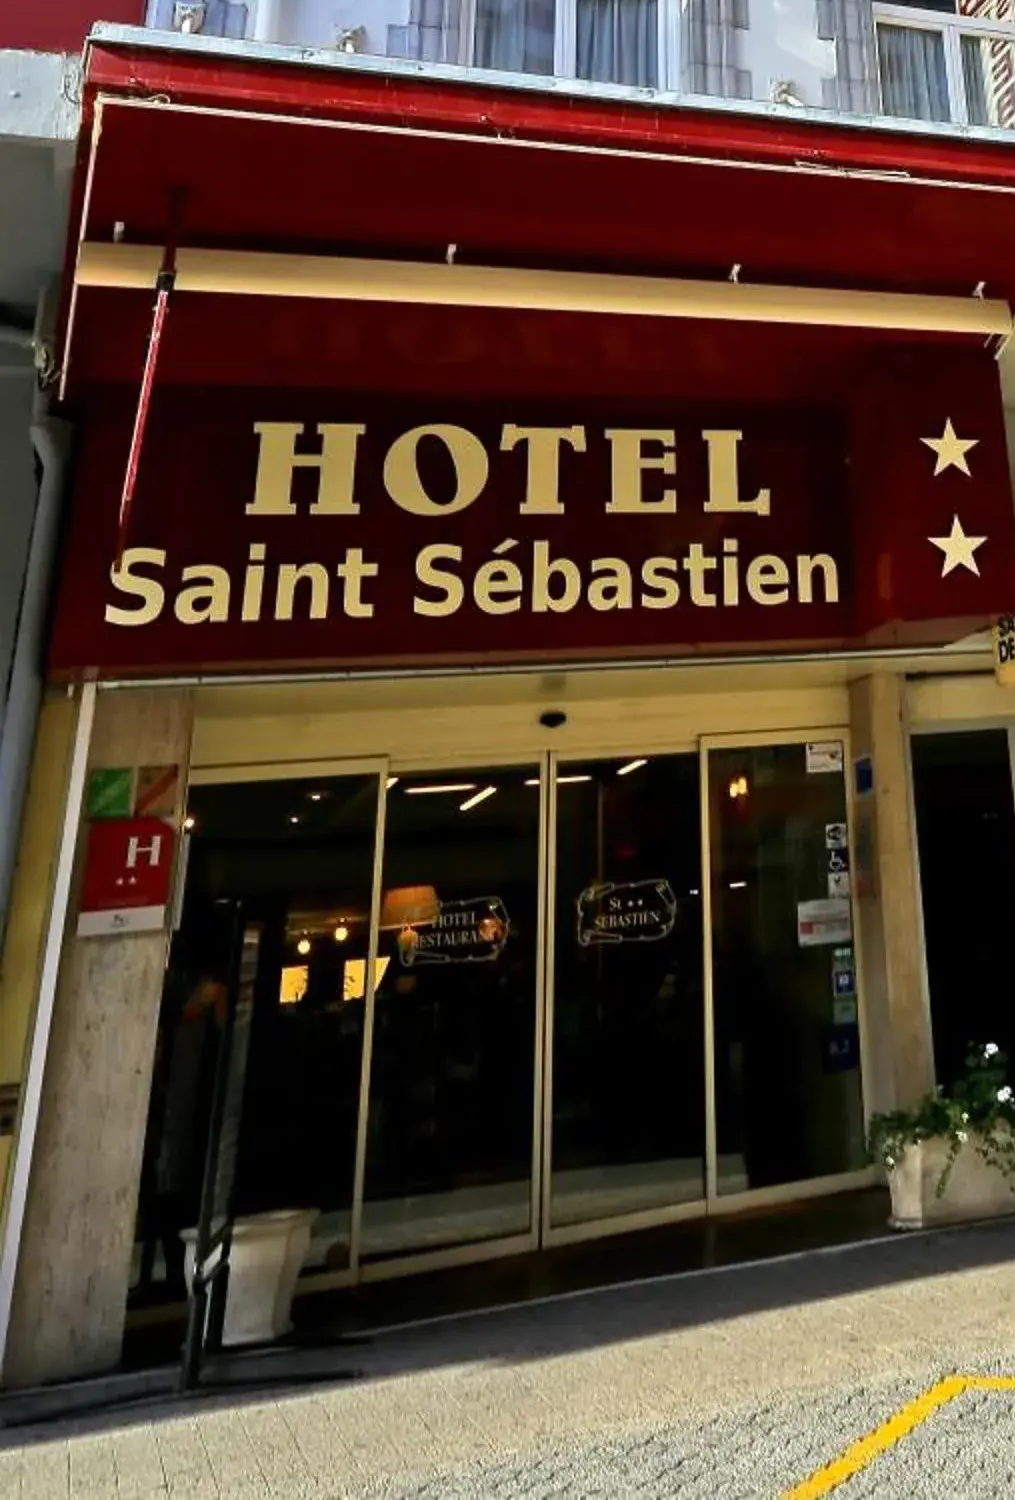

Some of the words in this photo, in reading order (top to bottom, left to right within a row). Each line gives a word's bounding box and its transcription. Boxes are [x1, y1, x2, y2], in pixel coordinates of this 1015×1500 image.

[245, 422, 771, 517] HOTEL
[104, 543, 379, 626] Saint
[412, 538, 840, 617] Sébastien
[999, 637, 1015, 662] DE
[126, 835, 162, 868] H
